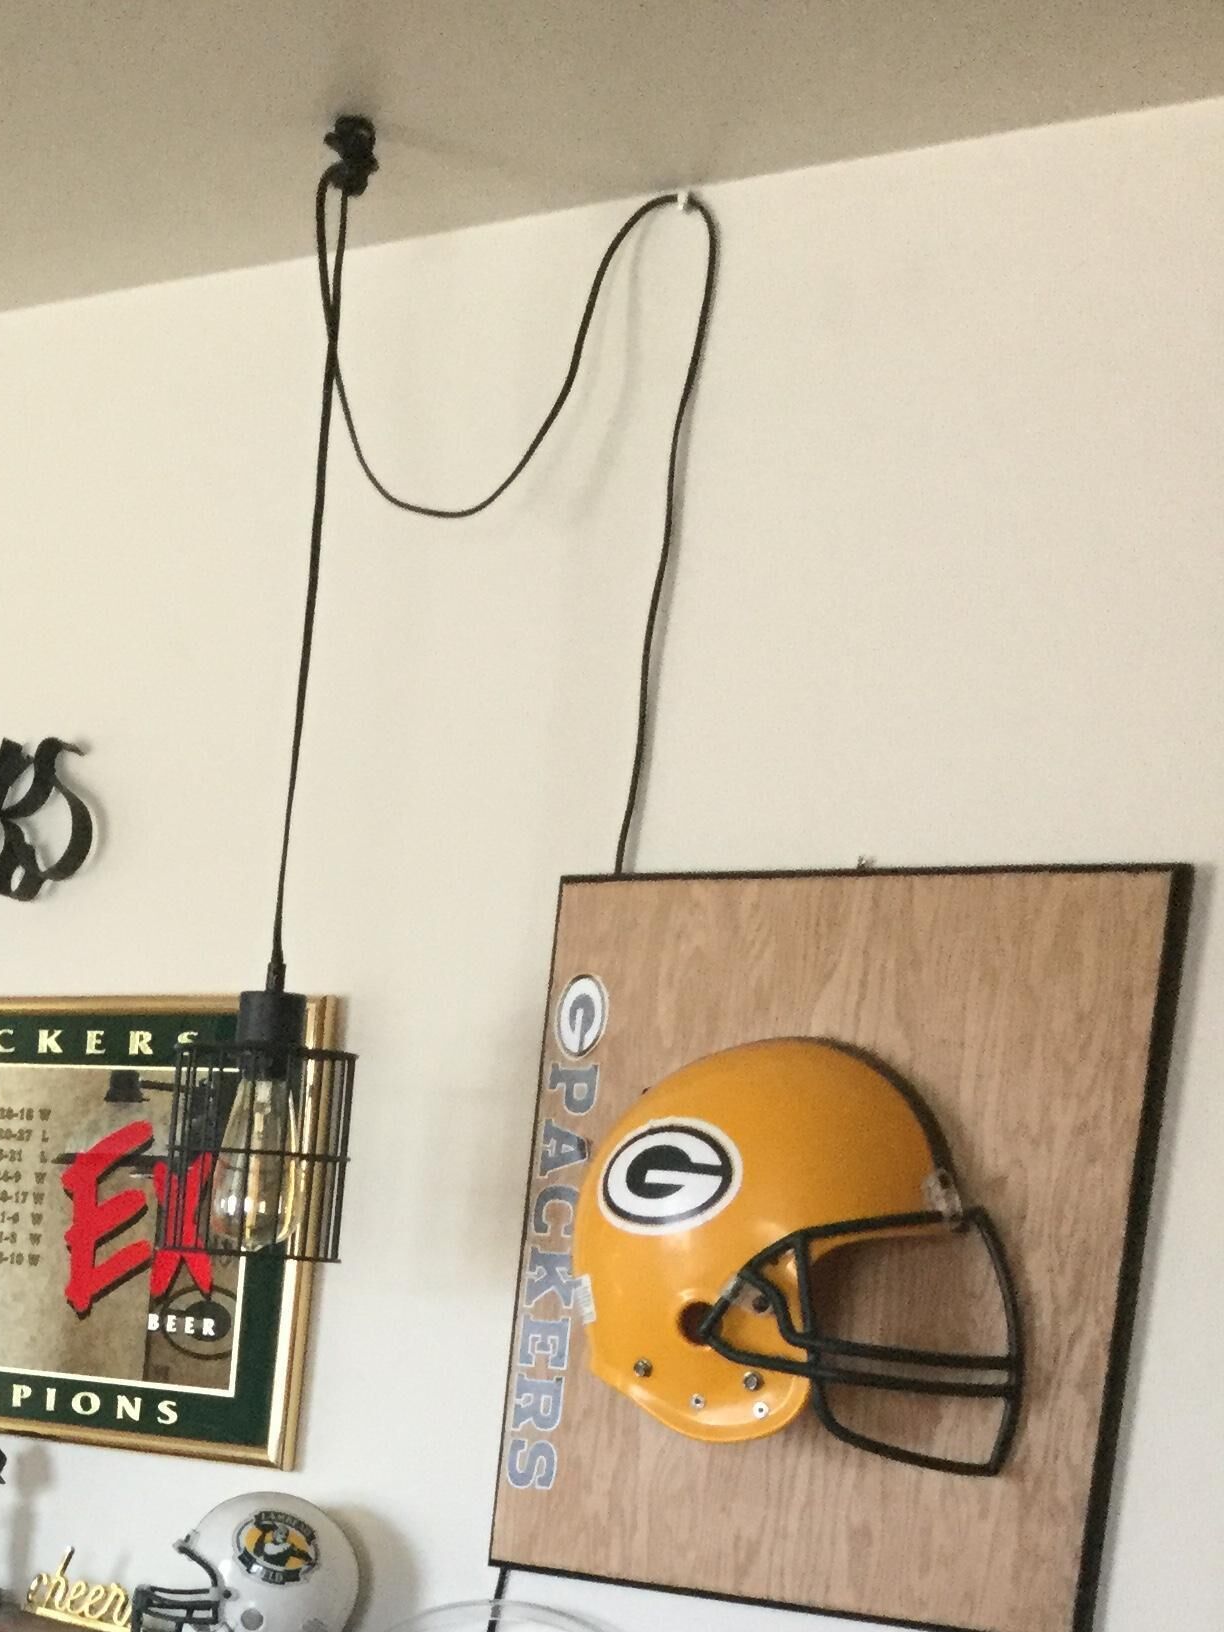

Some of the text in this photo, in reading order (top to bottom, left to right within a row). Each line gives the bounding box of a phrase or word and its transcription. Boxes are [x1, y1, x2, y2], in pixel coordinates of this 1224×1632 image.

[507, 1062, 601, 1491] PACKERS
[147, 1312, 216, 1337] BEER
[27, 1546, 132, 1626] cheer
